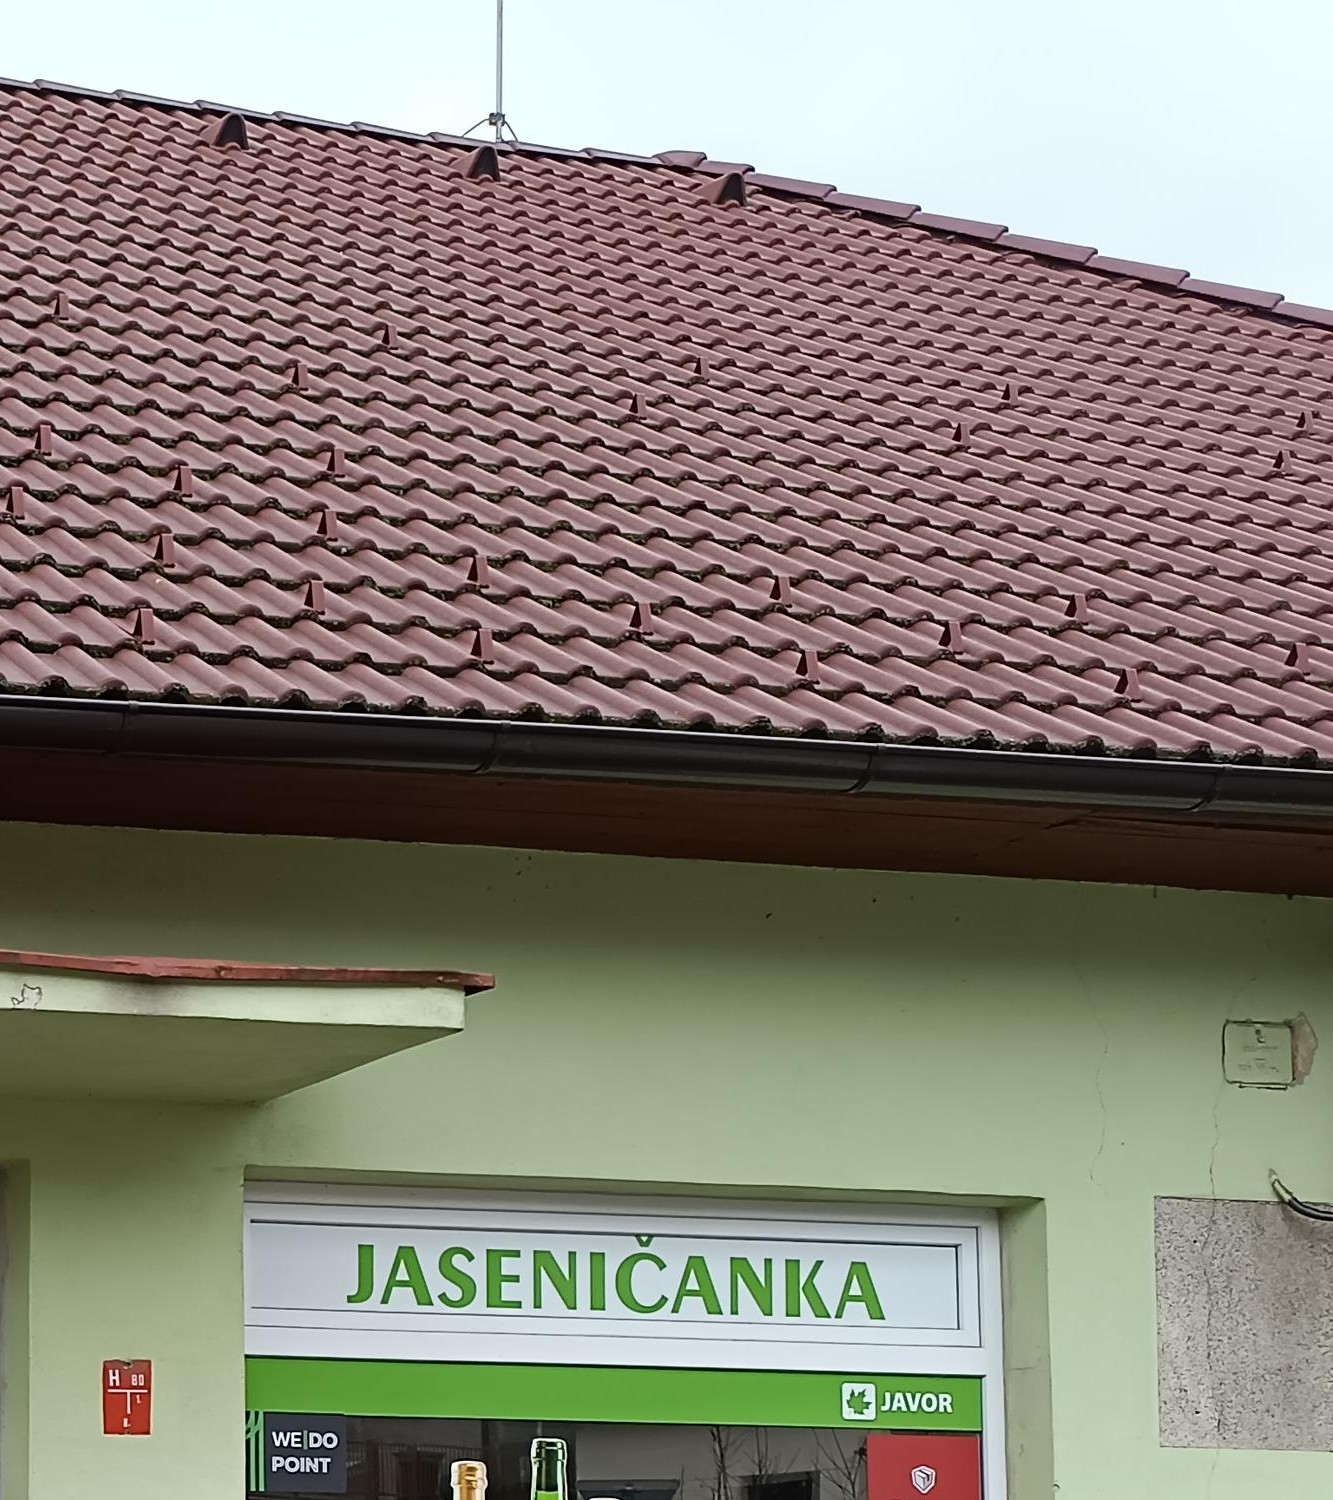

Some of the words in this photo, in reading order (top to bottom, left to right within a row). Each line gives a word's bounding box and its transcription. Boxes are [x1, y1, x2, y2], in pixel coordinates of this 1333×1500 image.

[346, 1235, 887, 1321] JASENIČANKA
[108, 1369, 120, 1387] H
[879, 1390, 955, 1415] JAVOR
[271, 1455, 332, 1473] POINT
